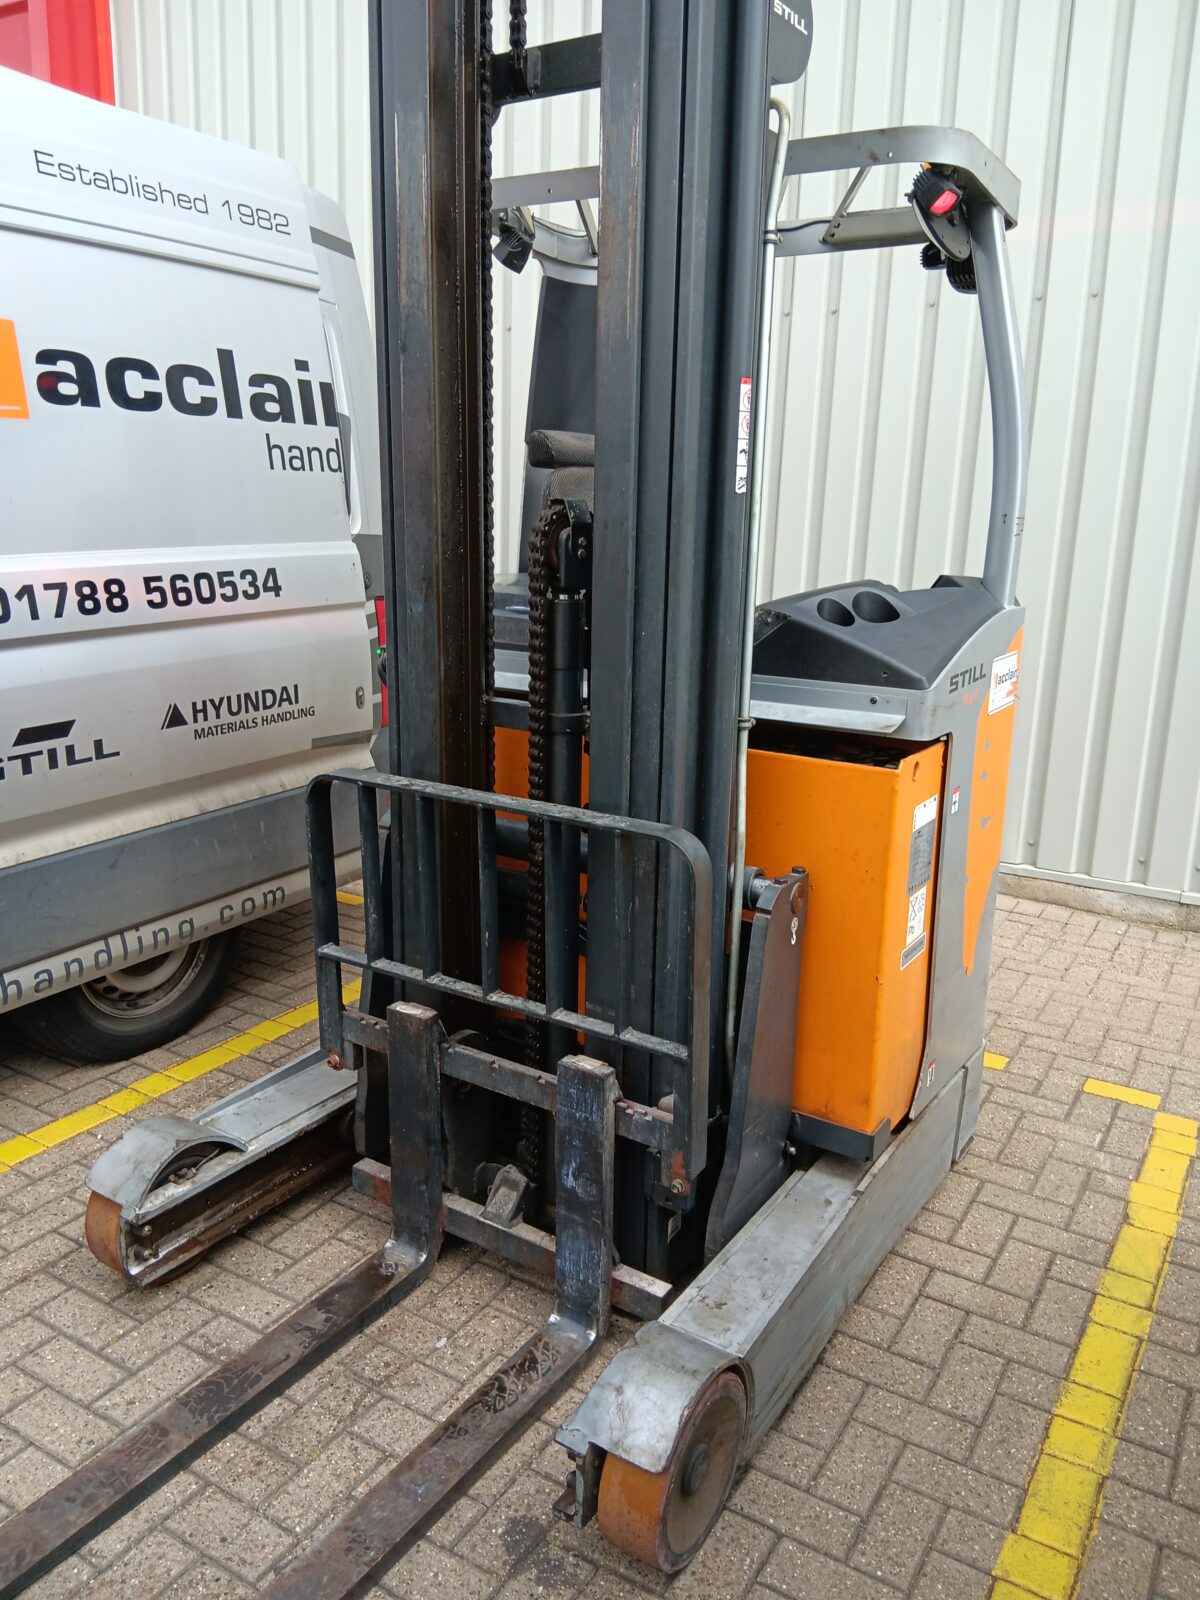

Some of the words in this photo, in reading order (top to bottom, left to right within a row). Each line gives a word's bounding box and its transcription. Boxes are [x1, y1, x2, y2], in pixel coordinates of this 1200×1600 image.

[773, 0, 808, 35] STILL
[33, 149, 209, 215] Established
[221, 199, 291, 236] 1982
[35, 347, 339, 428] acclai
[265, 432, 343, 474] hand
[143, 567, 282, 610] 560534
[949, 663, 986, 694] STILL
[191, 683, 300, 725] HYUNDAI
[193, 719, 259, 741] MATERIALS
[260, 705, 315, 727] HANDLING
